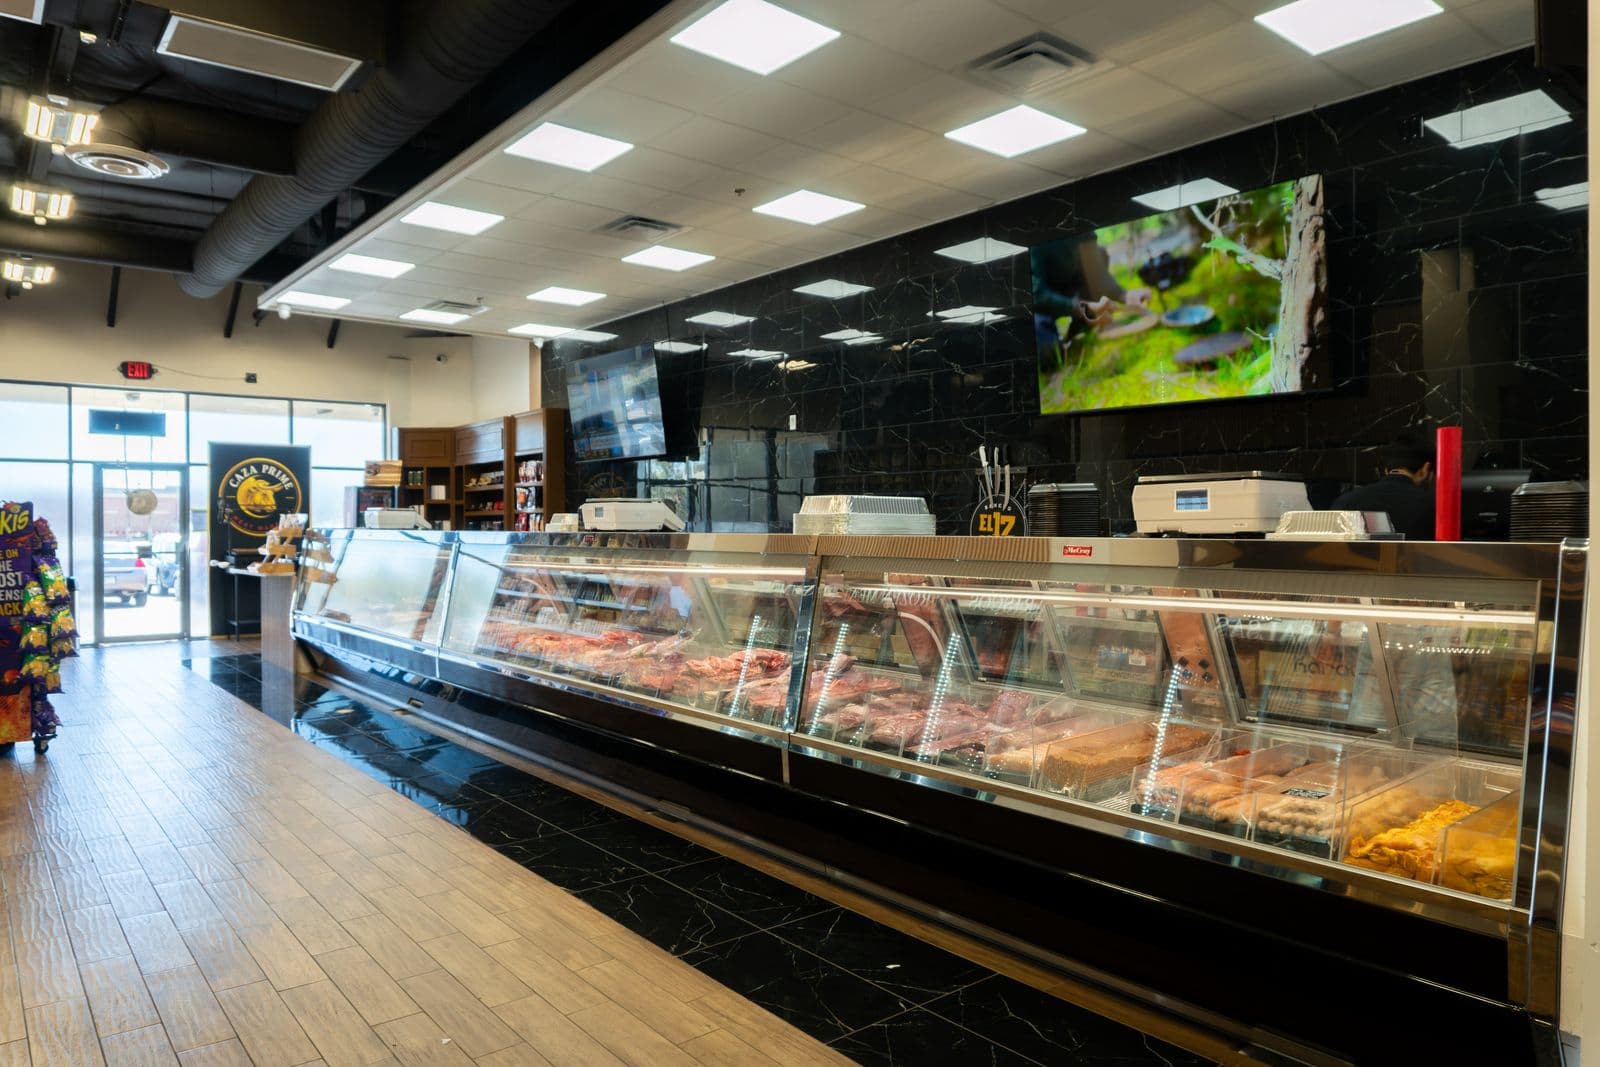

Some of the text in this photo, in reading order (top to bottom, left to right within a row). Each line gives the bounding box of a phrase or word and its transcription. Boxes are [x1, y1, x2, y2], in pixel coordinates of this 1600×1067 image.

[127, 362, 149, 377] EXIT
[228, 464, 294, 491] CAZA PRIME
[979, 511, 1016, 536] EL 17
[6, 549, 19, 559] ON
